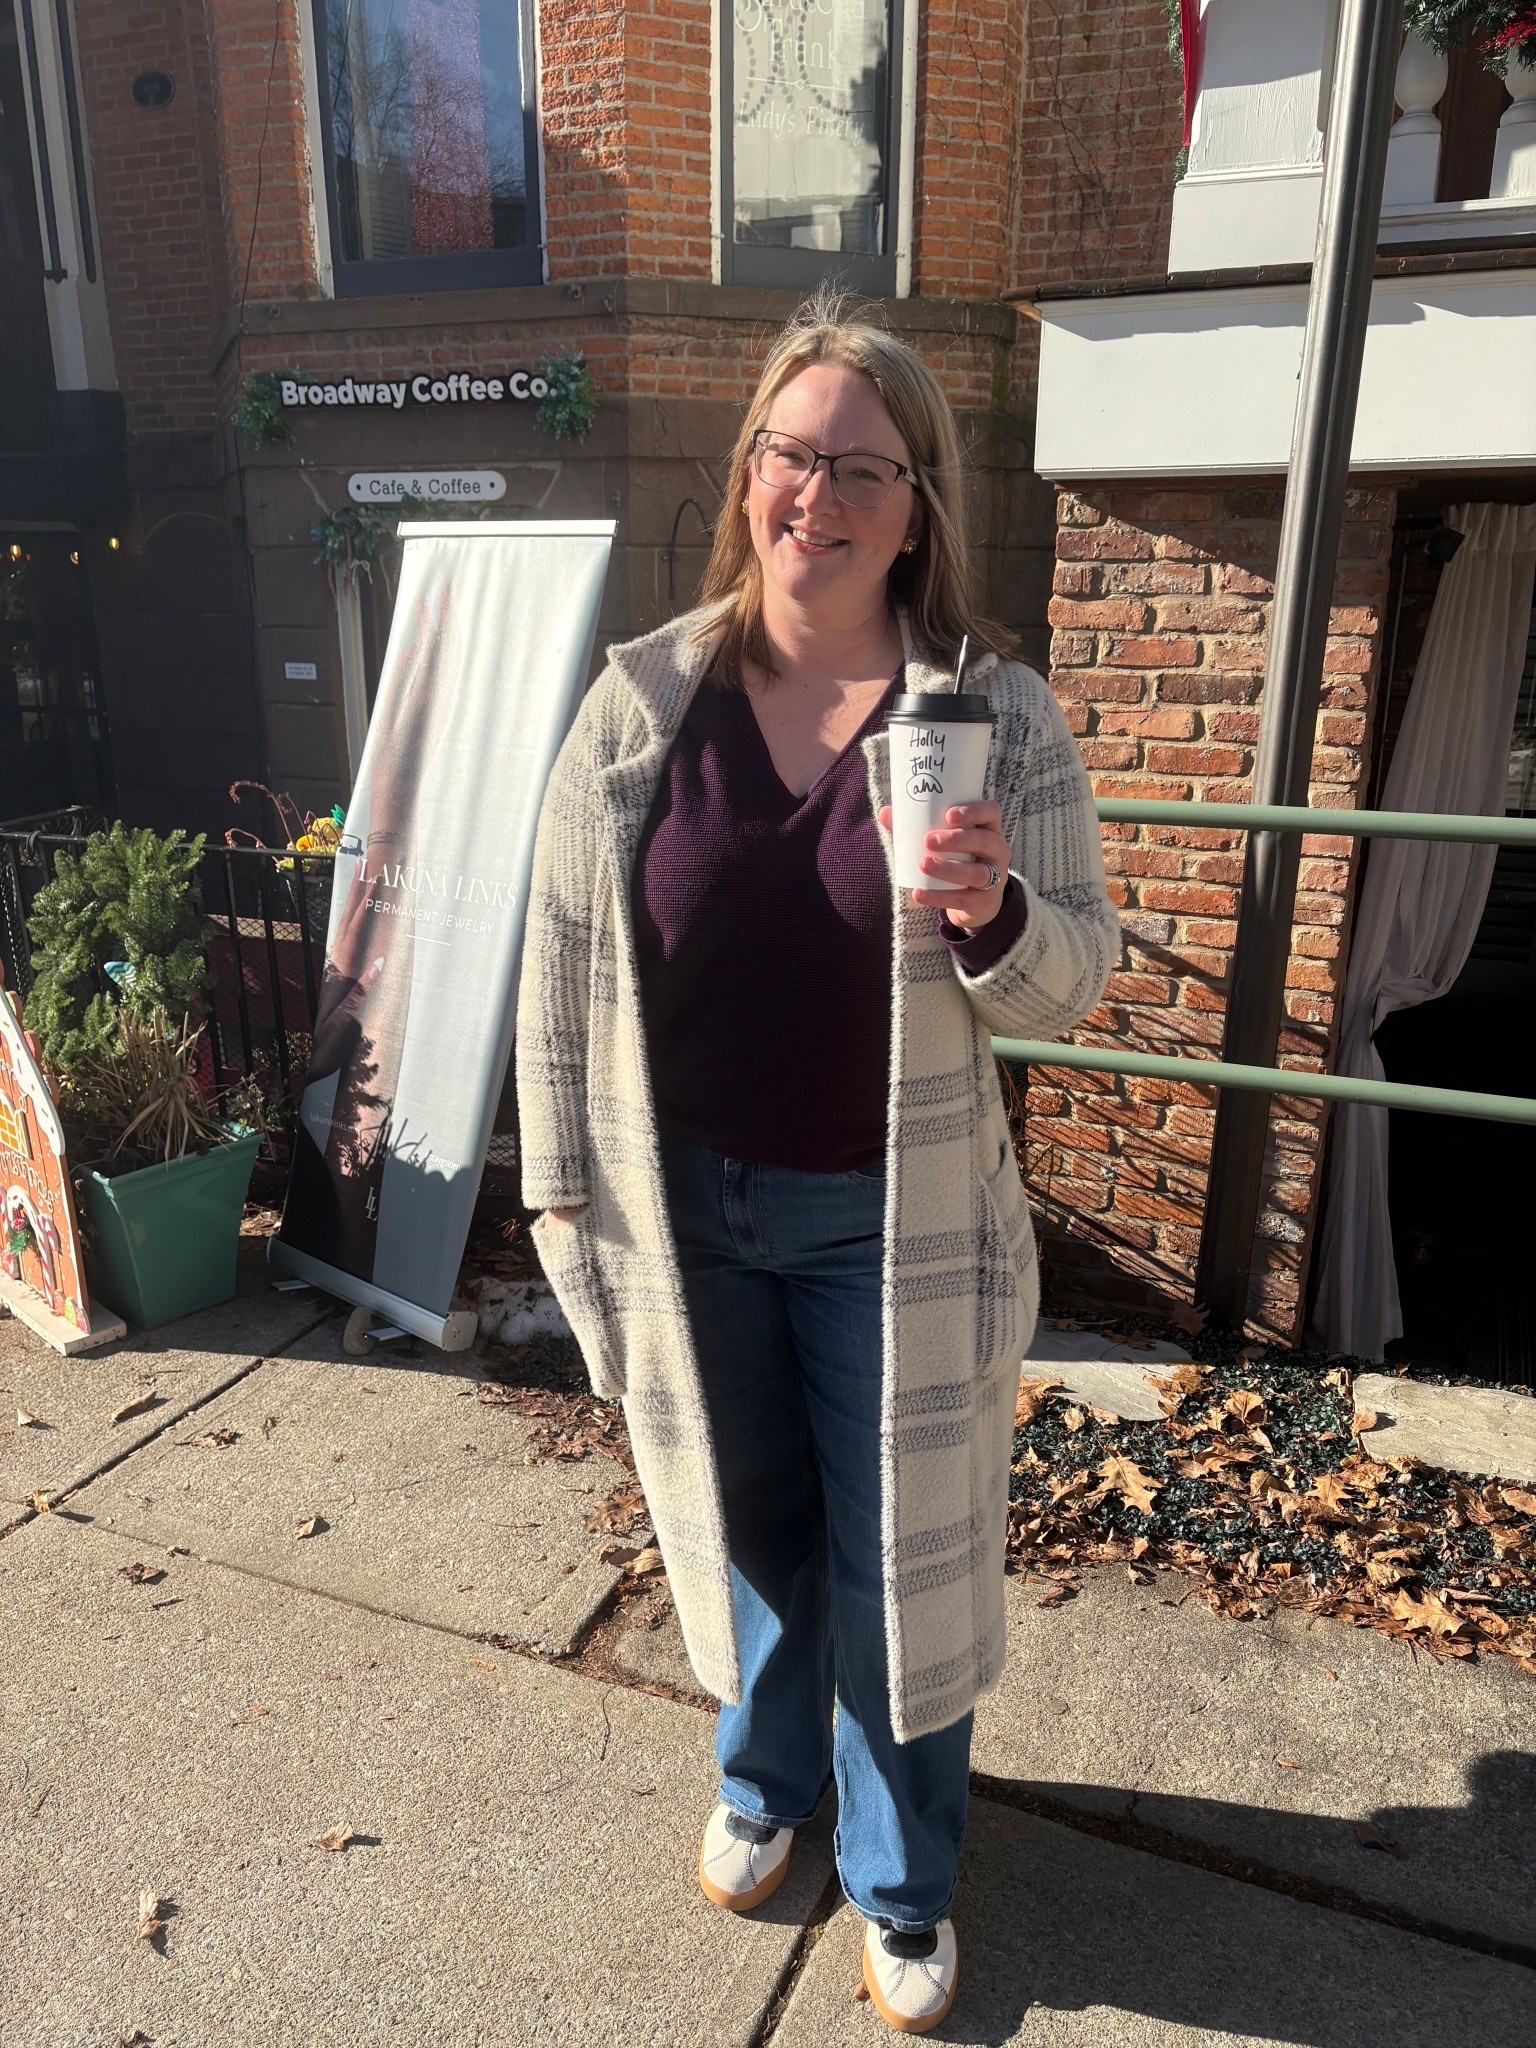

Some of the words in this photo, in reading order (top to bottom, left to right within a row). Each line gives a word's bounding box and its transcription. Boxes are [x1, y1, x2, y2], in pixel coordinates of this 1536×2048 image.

[736, 98, 796, 139] Lady's
[806, 106, 865, 146] Finery
[281, 378, 406, 408] Broadway
[411, 373, 504, 404] Coffee
[509, 371, 557, 400] Co.
[369, 480, 405, 496] Cafe
[411, 480, 423, 495] &
[428, 478, 481, 495] Coffee
[910, 727, 945, 752] Holly
[909, 755, 945, 776] Jolly
[359, 858, 447, 898] LAKUNA
[454, 875, 519, 911] LINKS
[365, 898, 438, 923] PERMANENT
[439, 914, 495, 935] JEWELRY
